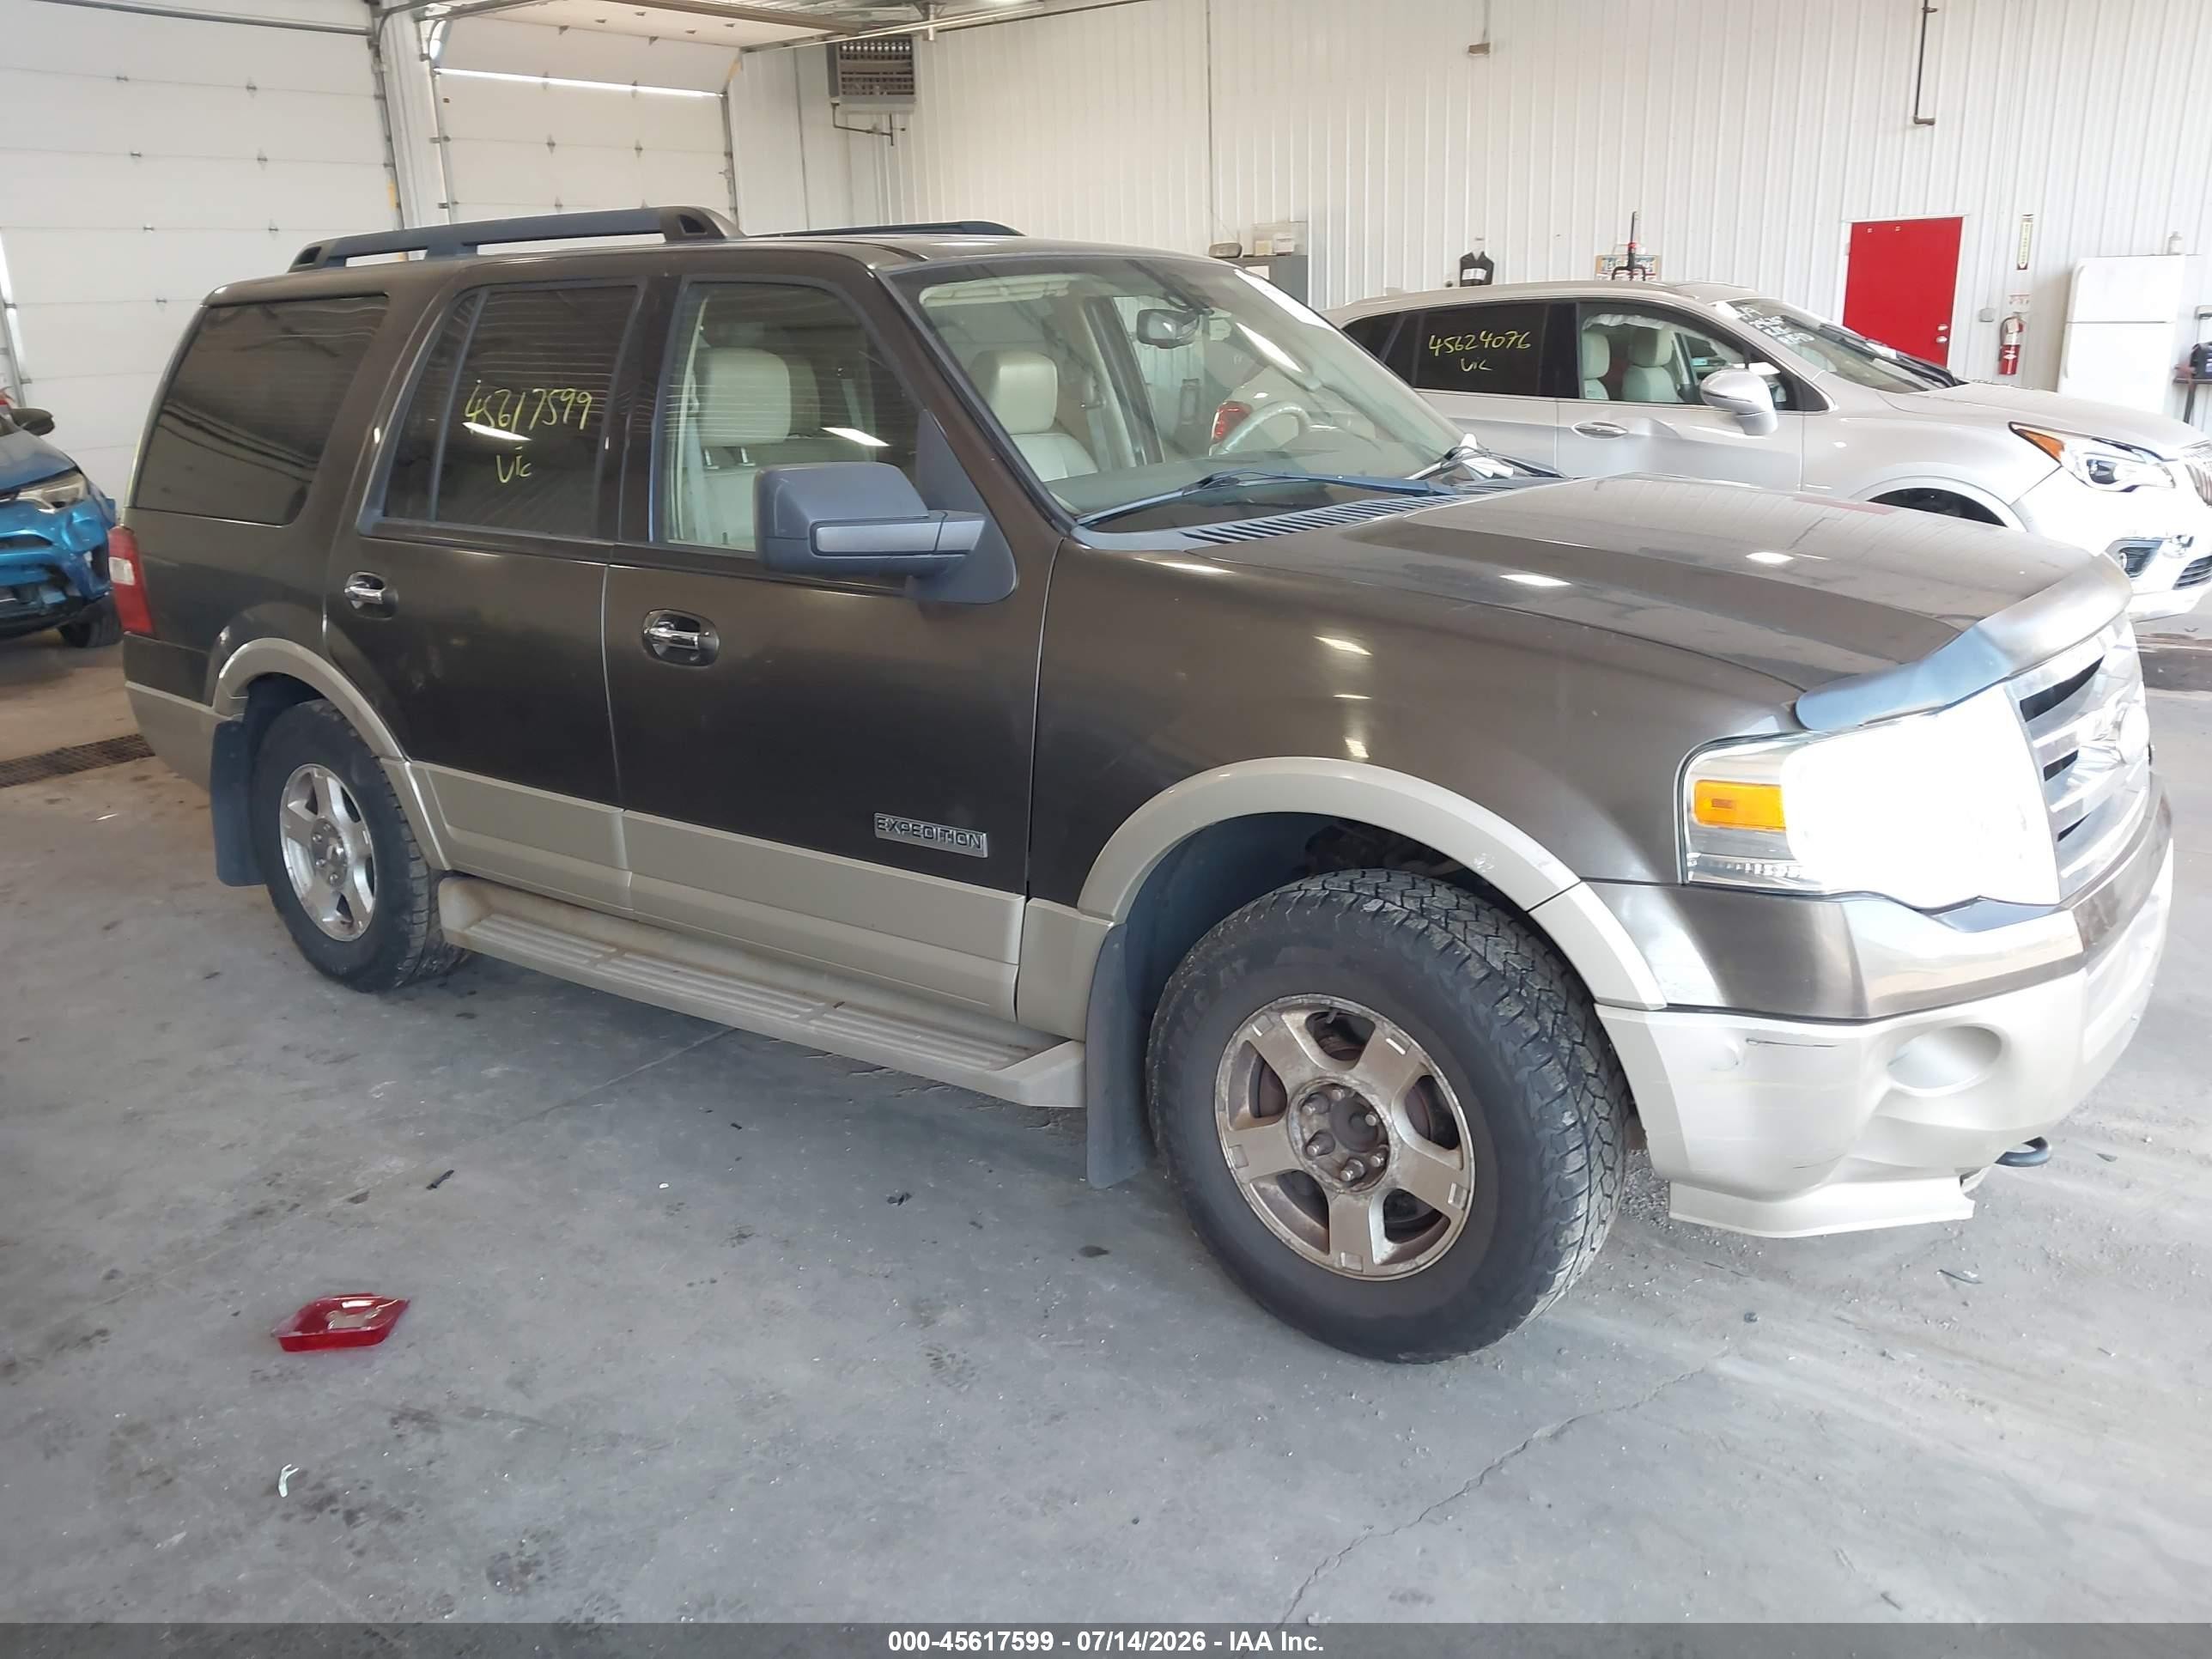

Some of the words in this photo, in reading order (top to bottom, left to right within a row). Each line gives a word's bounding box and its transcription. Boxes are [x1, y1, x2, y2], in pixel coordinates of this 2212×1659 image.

[1428, 330, 1532, 356] 45624076
[464, 384, 592, 434] 45617599
[877, 817, 983, 850] EXPEDITION
